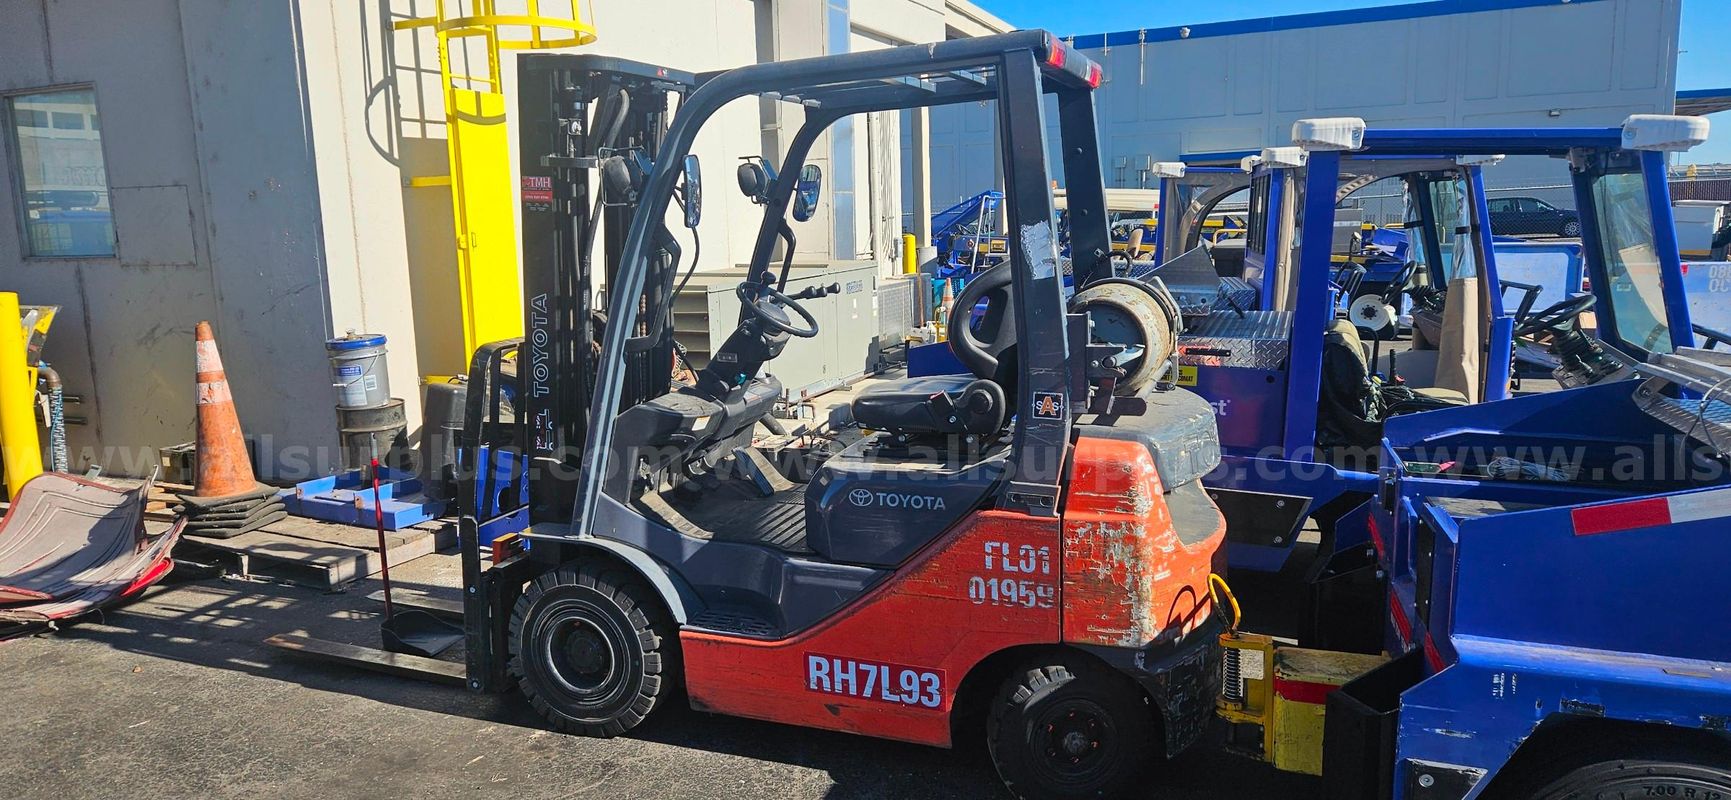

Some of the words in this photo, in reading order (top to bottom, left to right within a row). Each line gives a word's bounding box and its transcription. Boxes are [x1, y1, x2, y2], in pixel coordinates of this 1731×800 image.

[529, 176, 551, 189] TMH
[1709, 265, 1731, 279] 08
[531, 293, 549, 398] TOYOTA
[876, 492, 946, 511] TOYOTA
[984, 540, 1050, 574] FL01
[808, 655, 941, 708] RH7L93
[1643, 785, 1677, 797] 7.00
[1684, 786, 1697, 799] R
